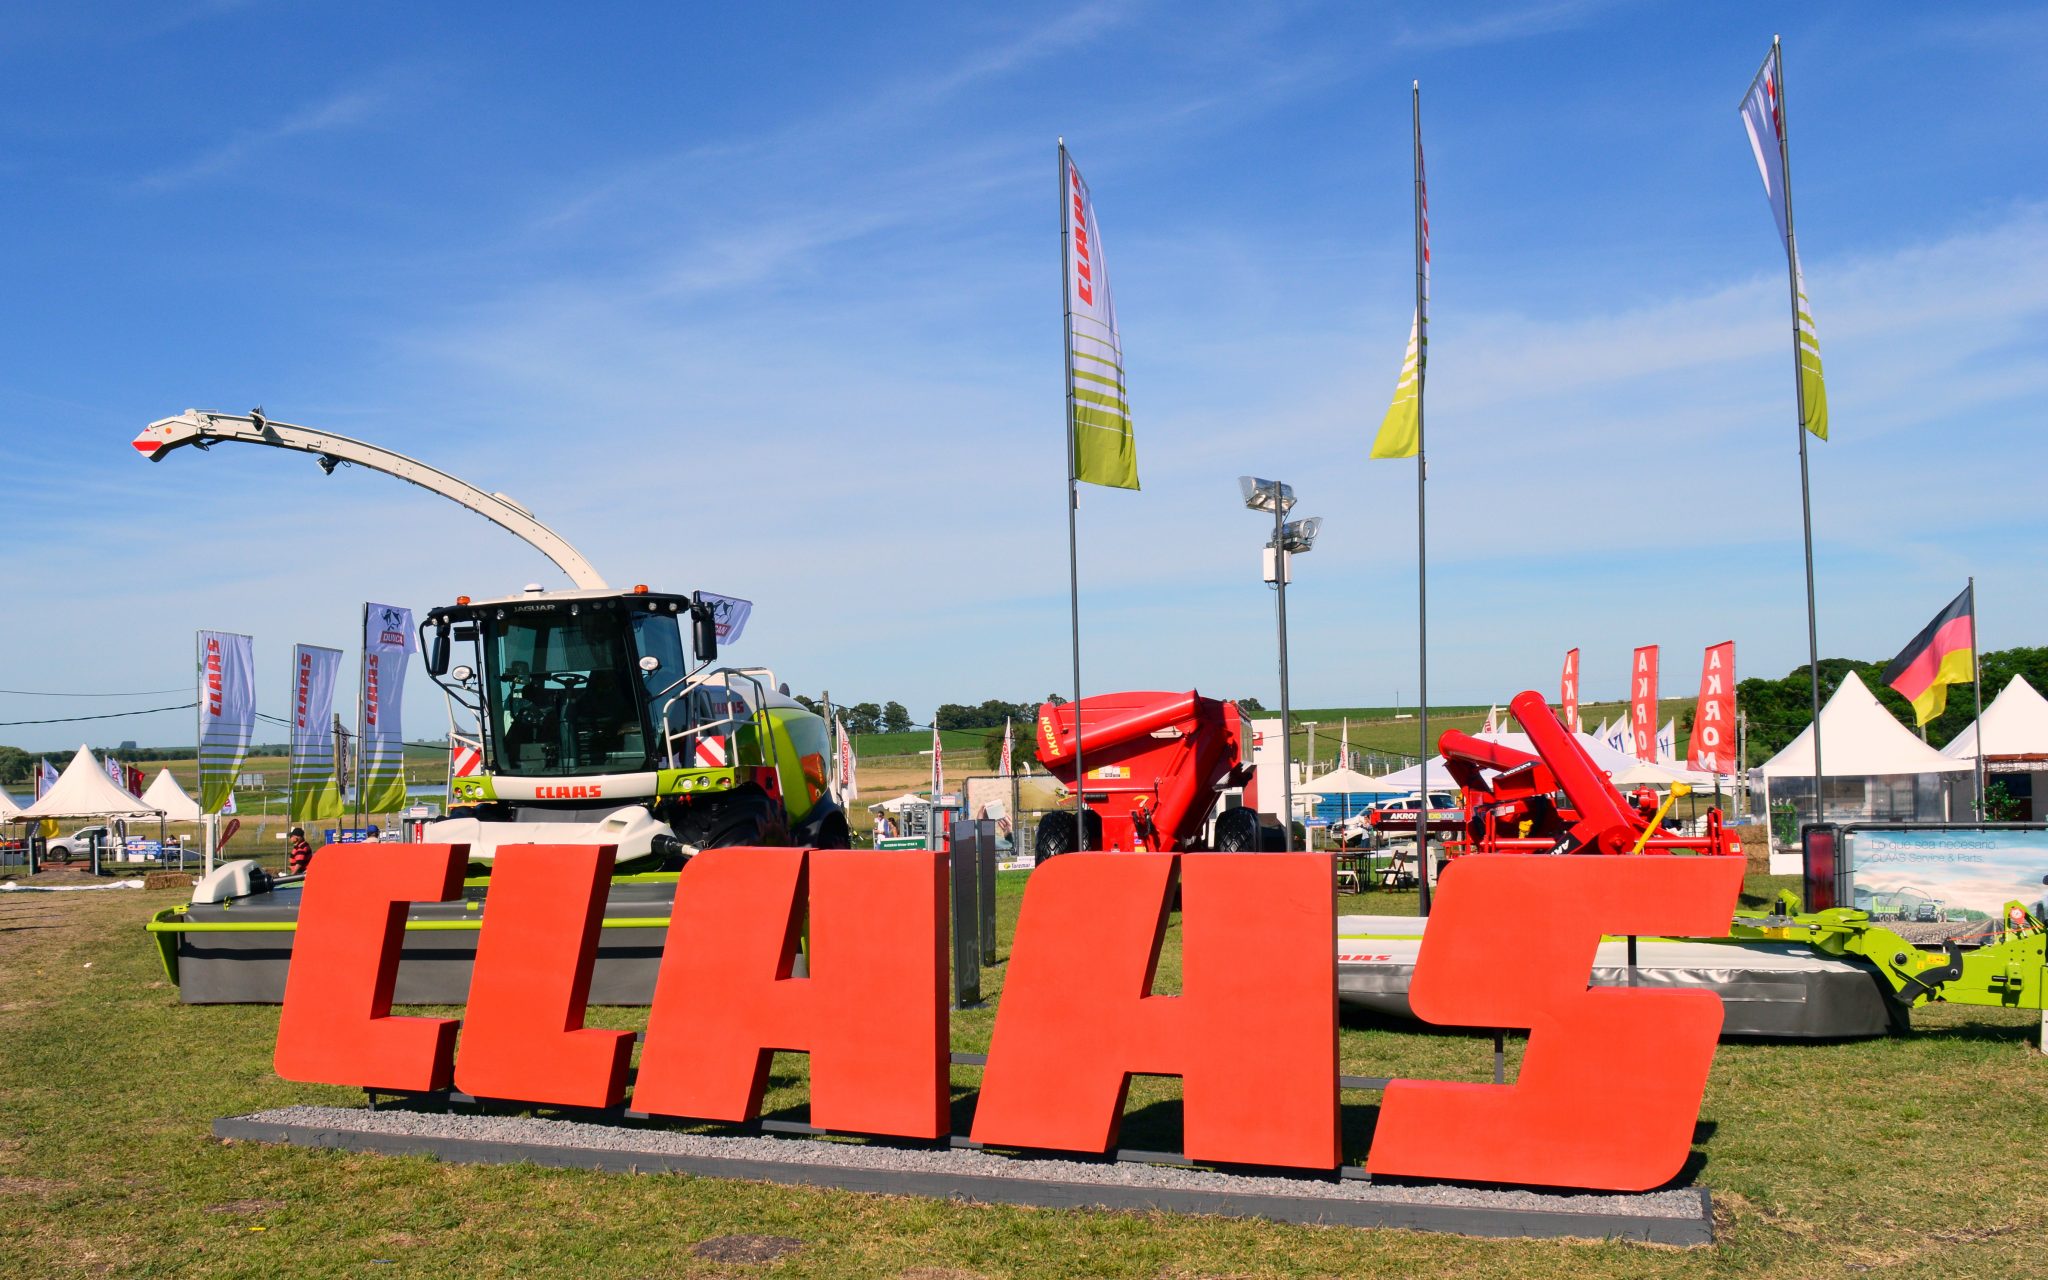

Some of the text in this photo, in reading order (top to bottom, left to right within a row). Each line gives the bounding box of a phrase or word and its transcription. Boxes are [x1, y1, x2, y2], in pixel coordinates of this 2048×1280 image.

[1069, 164, 1093, 307] CLAAS
[514, 604, 556, 612] JAGUAR
[207, 638, 223, 718] CLAAS
[298, 652, 311, 728] CLAAS
[367, 653, 379, 726] CLAAS
[1041, 716, 1061, 756] AKRON
[535, 785, 602, 799] CLAAS
[1871, 839, 1886, 850] Lo
[1889, 840, 1911, 851] que
[1914, 840, 1936, 850] sea
[1871, 853, 1906, 863] CLAAS
[273, 842, 1746, 1193] CLAAS
